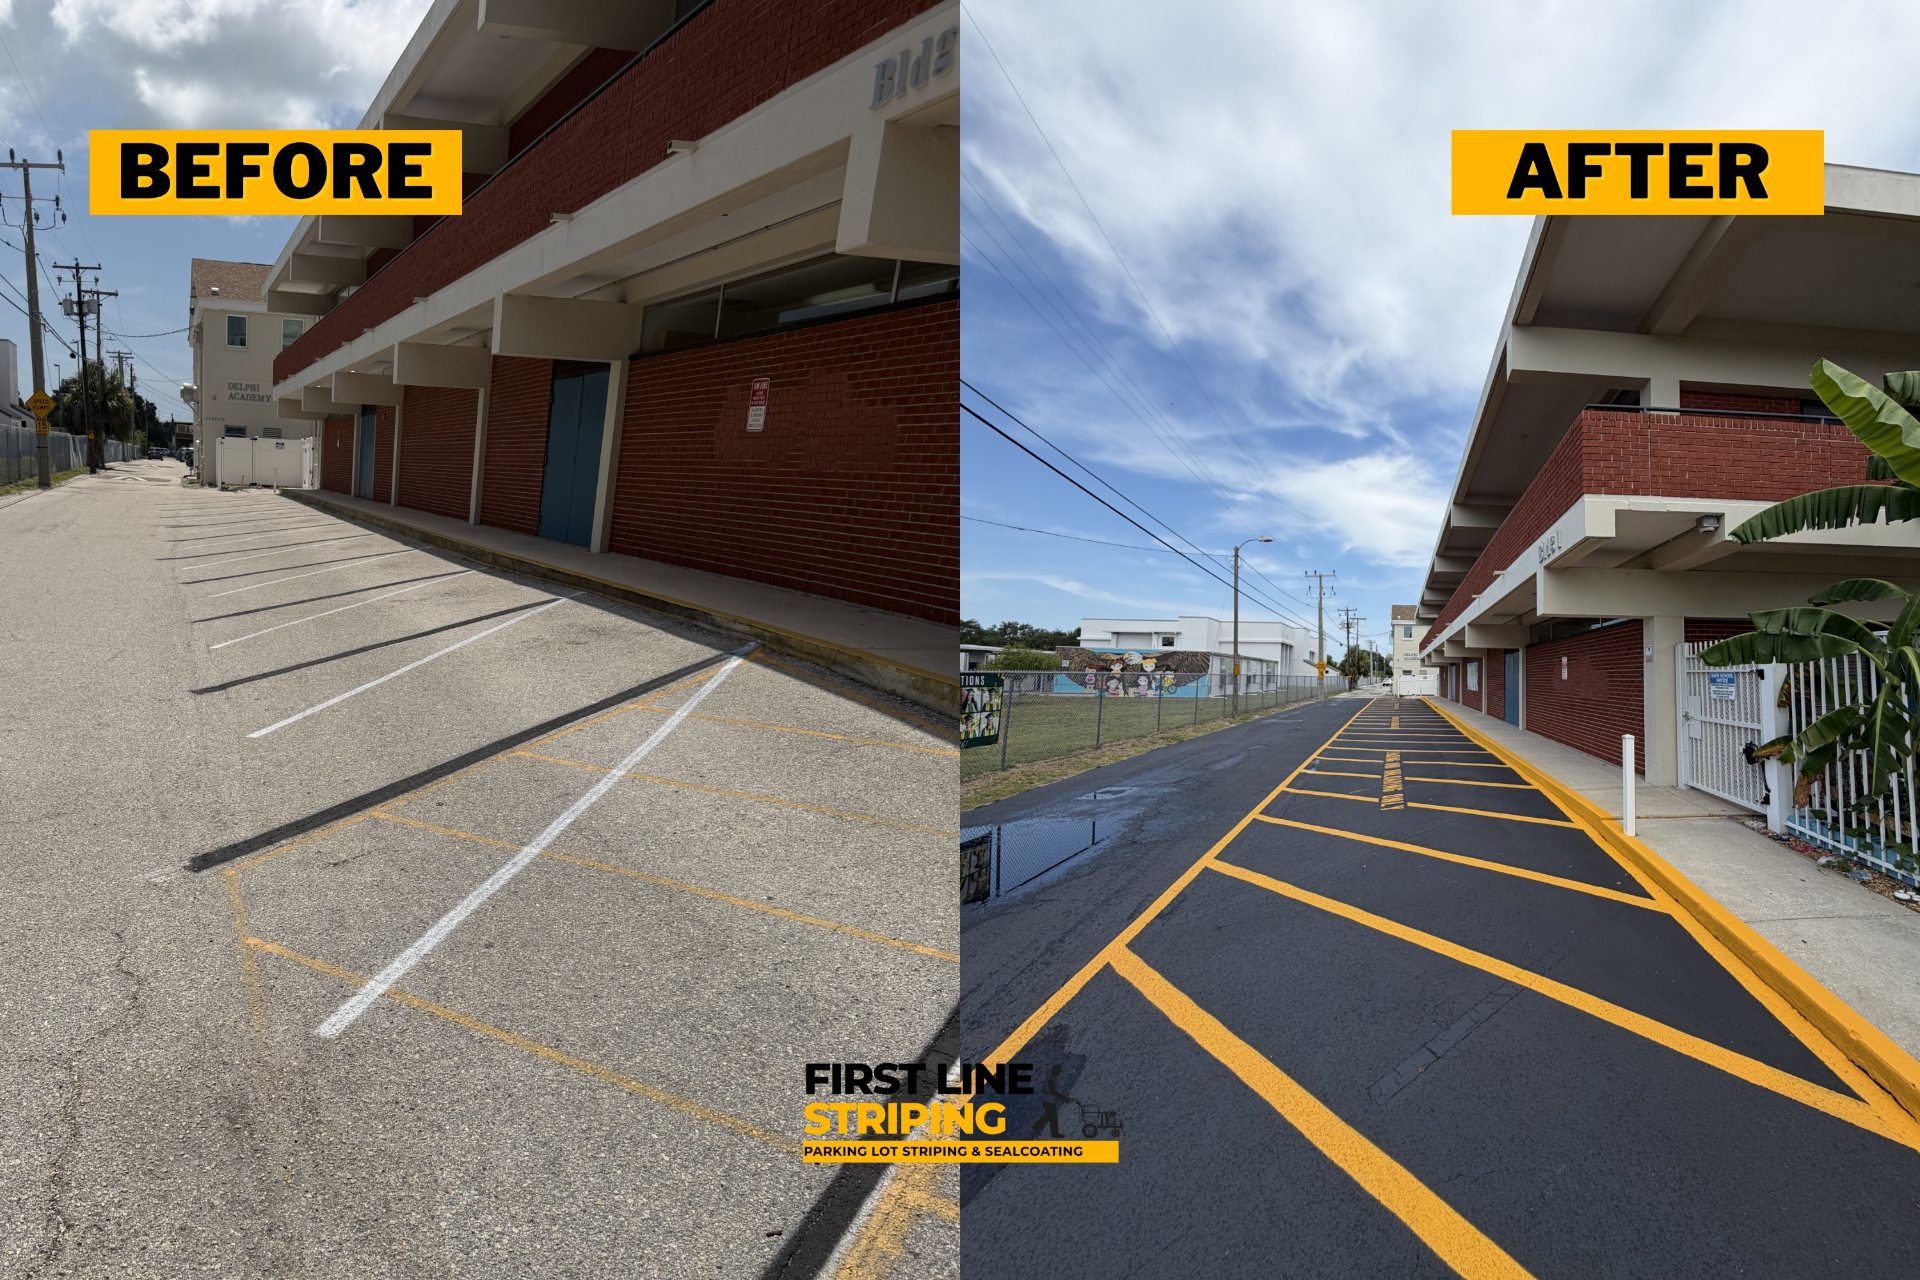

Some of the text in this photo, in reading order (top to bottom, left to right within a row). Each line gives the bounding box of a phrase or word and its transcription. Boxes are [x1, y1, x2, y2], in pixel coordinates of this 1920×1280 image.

[869, 26, 959, 111] Bldg
[228, 382, 260, 392] DELPHI
[228, 392, 272, 403] ACADEMY
[38, 421, 47, 430] 15
[960, 675, 985, 686] TIONS
